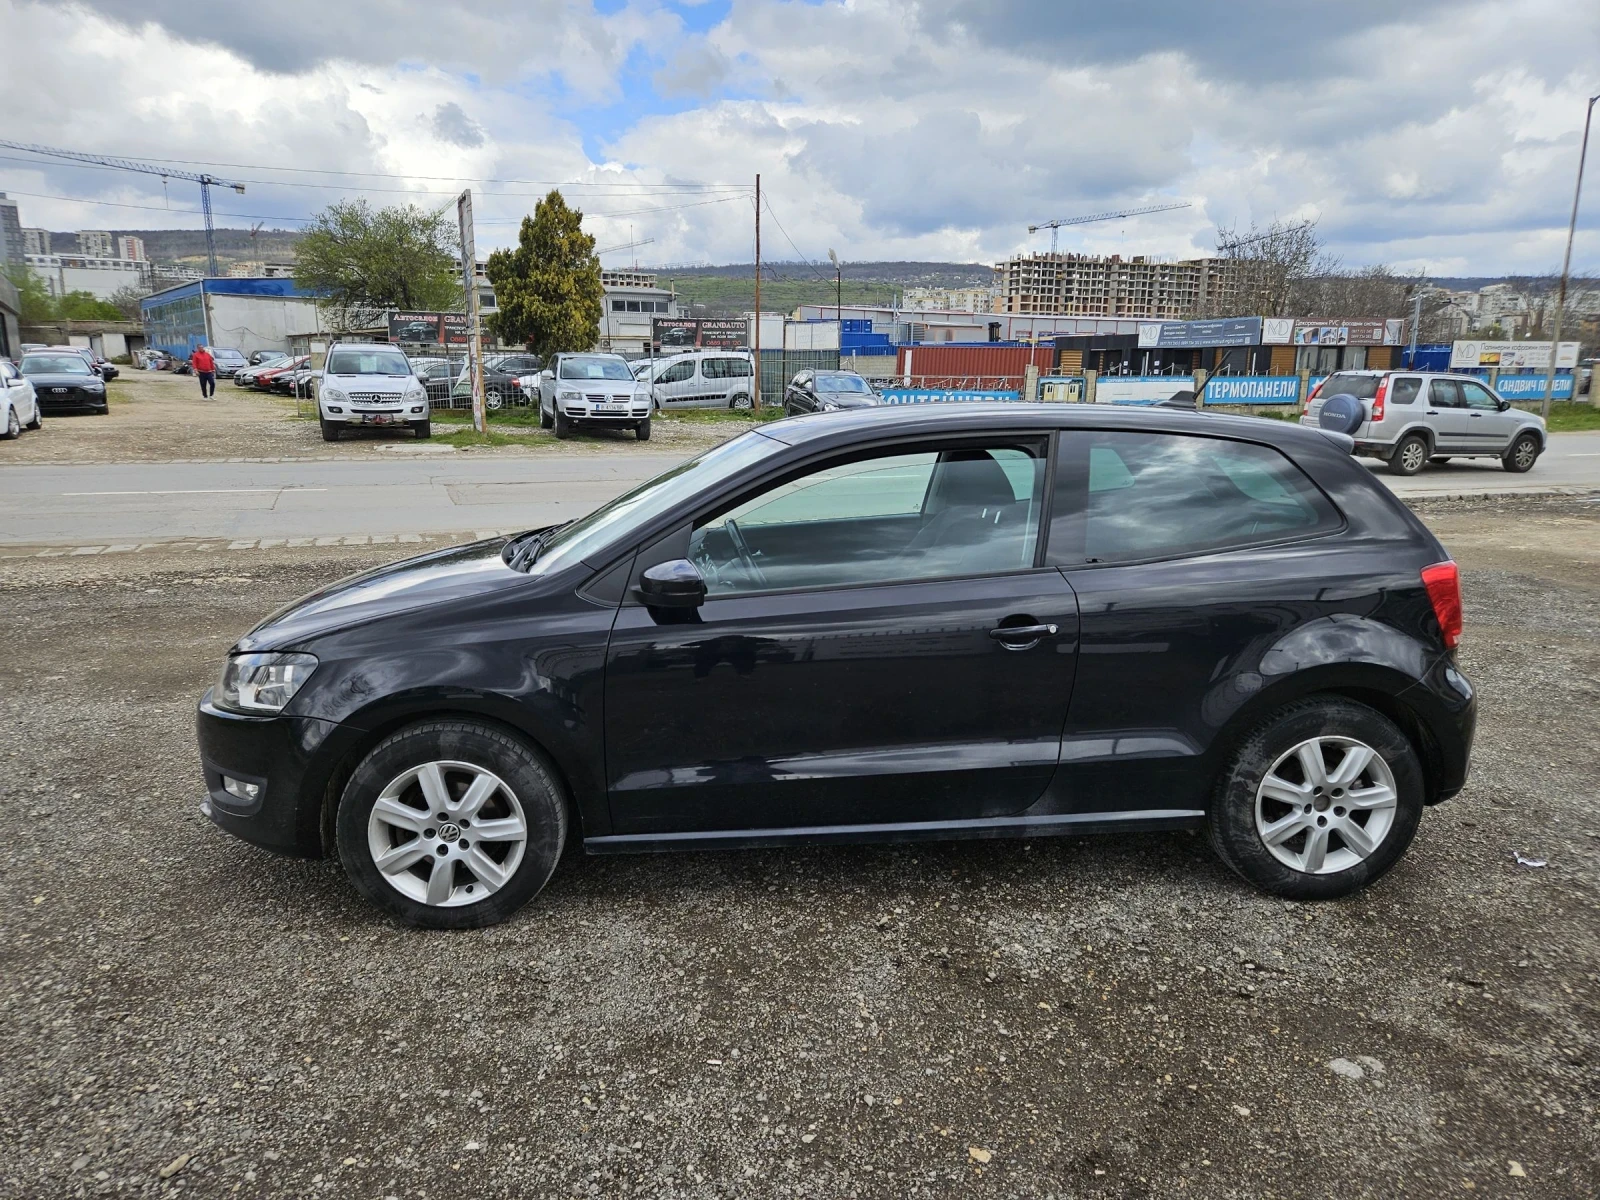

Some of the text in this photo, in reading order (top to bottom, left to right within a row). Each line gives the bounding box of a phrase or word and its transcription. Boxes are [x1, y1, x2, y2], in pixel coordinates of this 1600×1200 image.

[393, 313, 438, 322] Автосалон
[657, 320, 697, 328] Автосалон
[702, 321, 746, 329] GRANDAUTO
[1209, 380, 1297, 399] ТЕРМОПАНЕЛИ
[1498, 380, 1536, 394] САНДВИЧ
[880, 391, 1010, 405] ОНТЕЙ
[1323, 411, 1346, 419] HONDA
